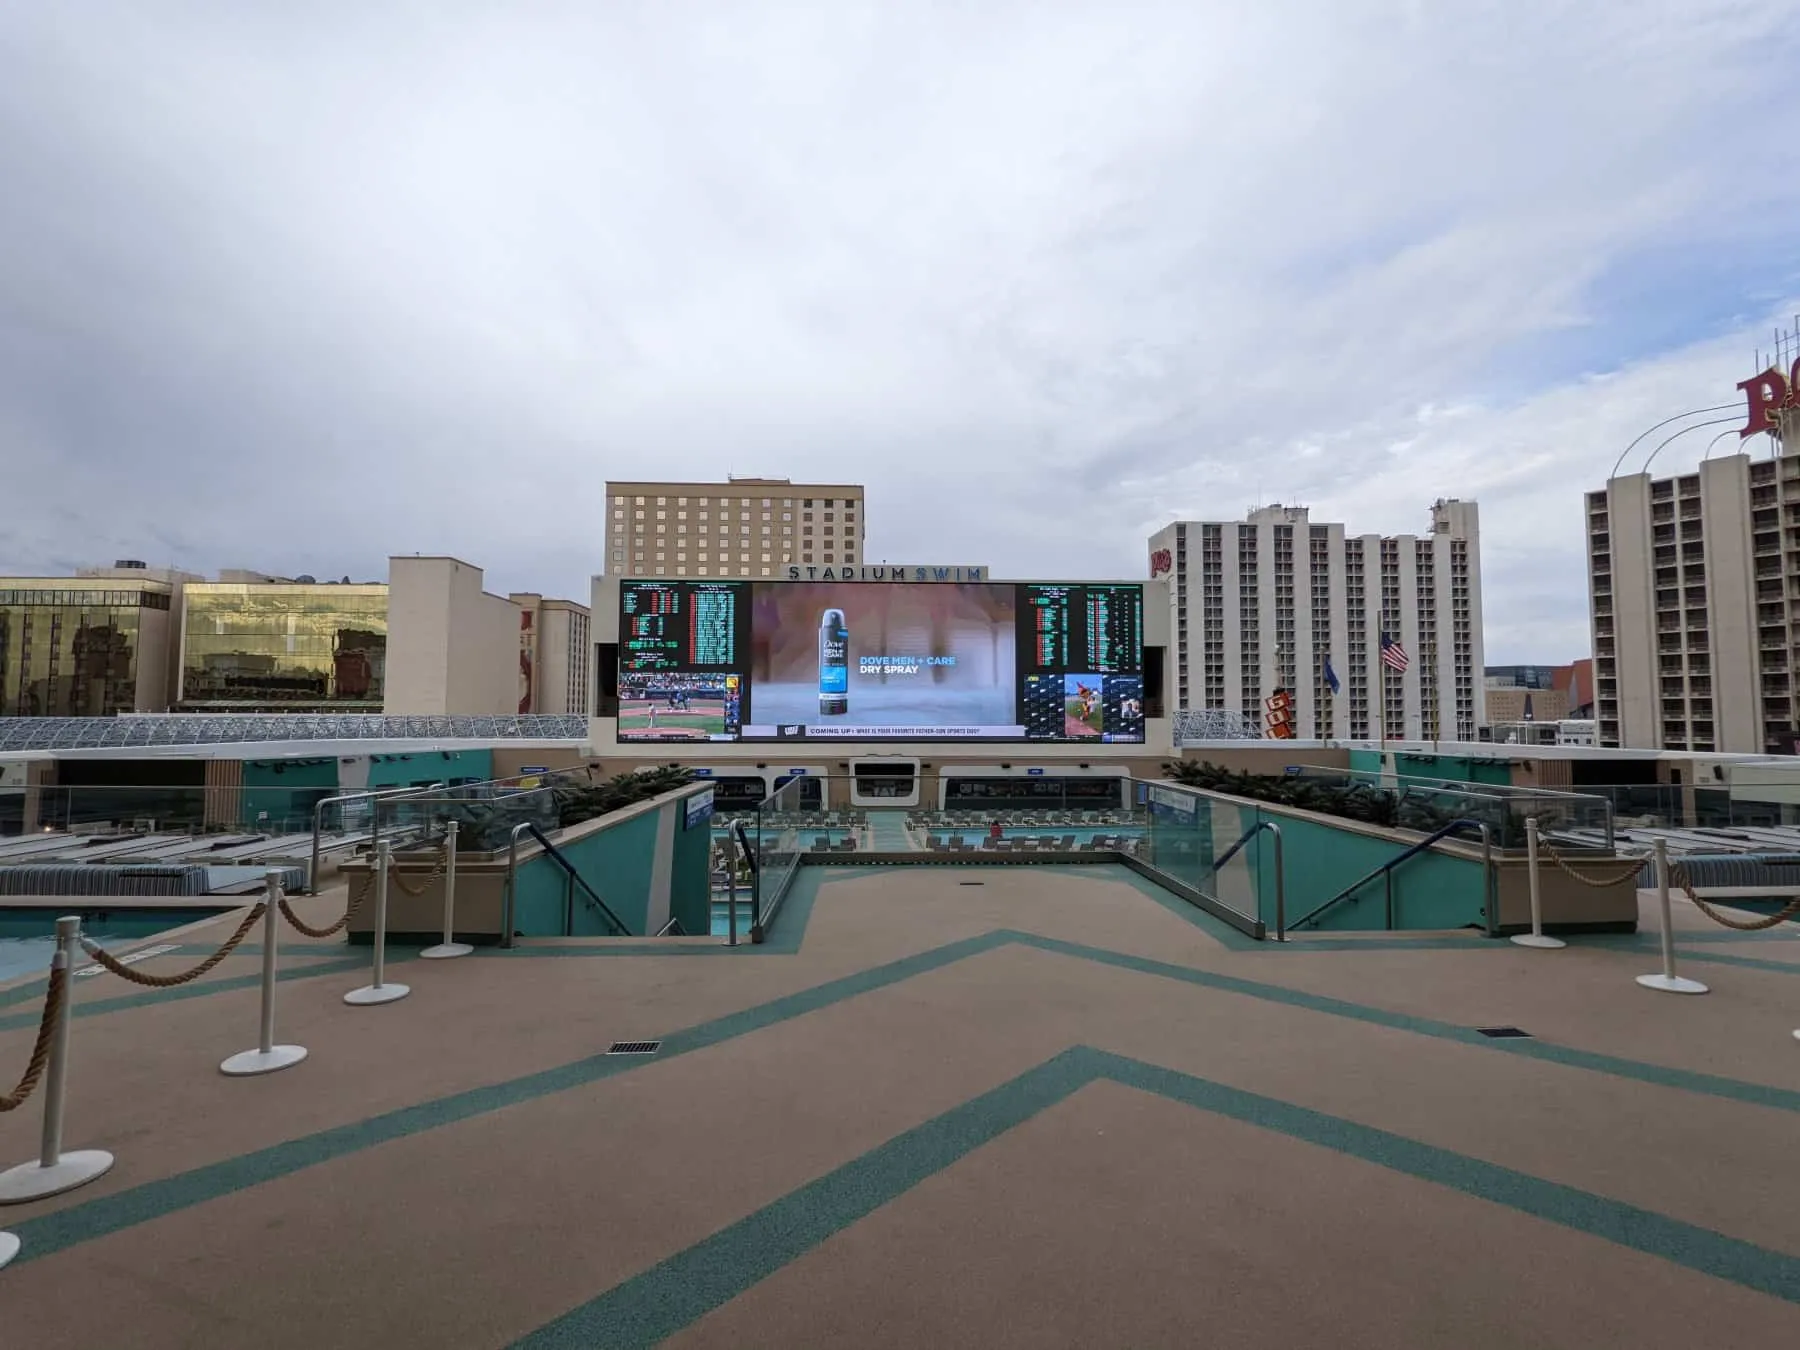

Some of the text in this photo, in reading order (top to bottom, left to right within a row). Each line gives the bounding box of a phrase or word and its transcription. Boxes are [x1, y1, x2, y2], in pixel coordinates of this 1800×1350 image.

[788, 566, 980, 581] STADIUM SWIM
[860, 656, 889, 665] DOVE
[892, 656, 915, 665] MEN
[927, 656, 956, 665] CARE
[860, 665, 919, 674] DRY SPRAY
